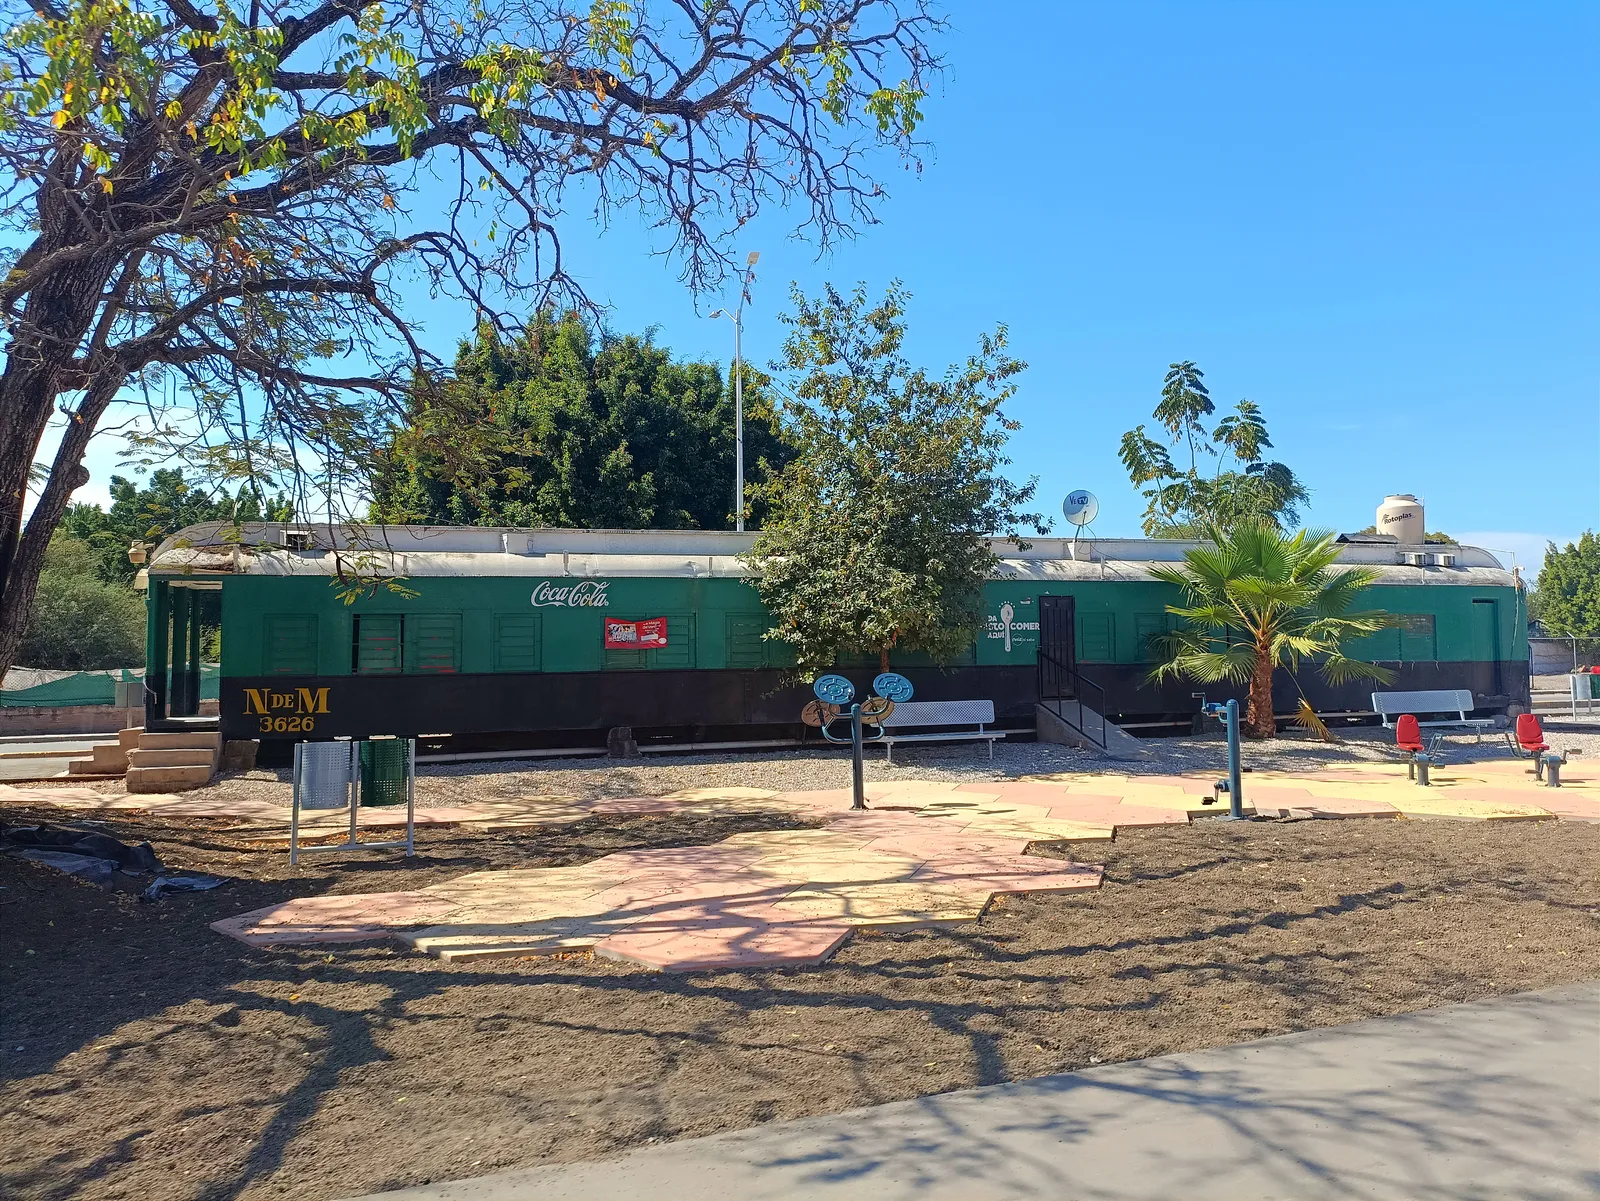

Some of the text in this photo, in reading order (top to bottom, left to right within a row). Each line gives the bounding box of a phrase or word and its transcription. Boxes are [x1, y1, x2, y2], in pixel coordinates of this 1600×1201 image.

[1384, 512, 1412, 524] Rotoplas
[531, 581, 610, 606] Coca-Cola
[1010, 622, 1040, 630] COMER
[260, 716, 314, 732] 3626
